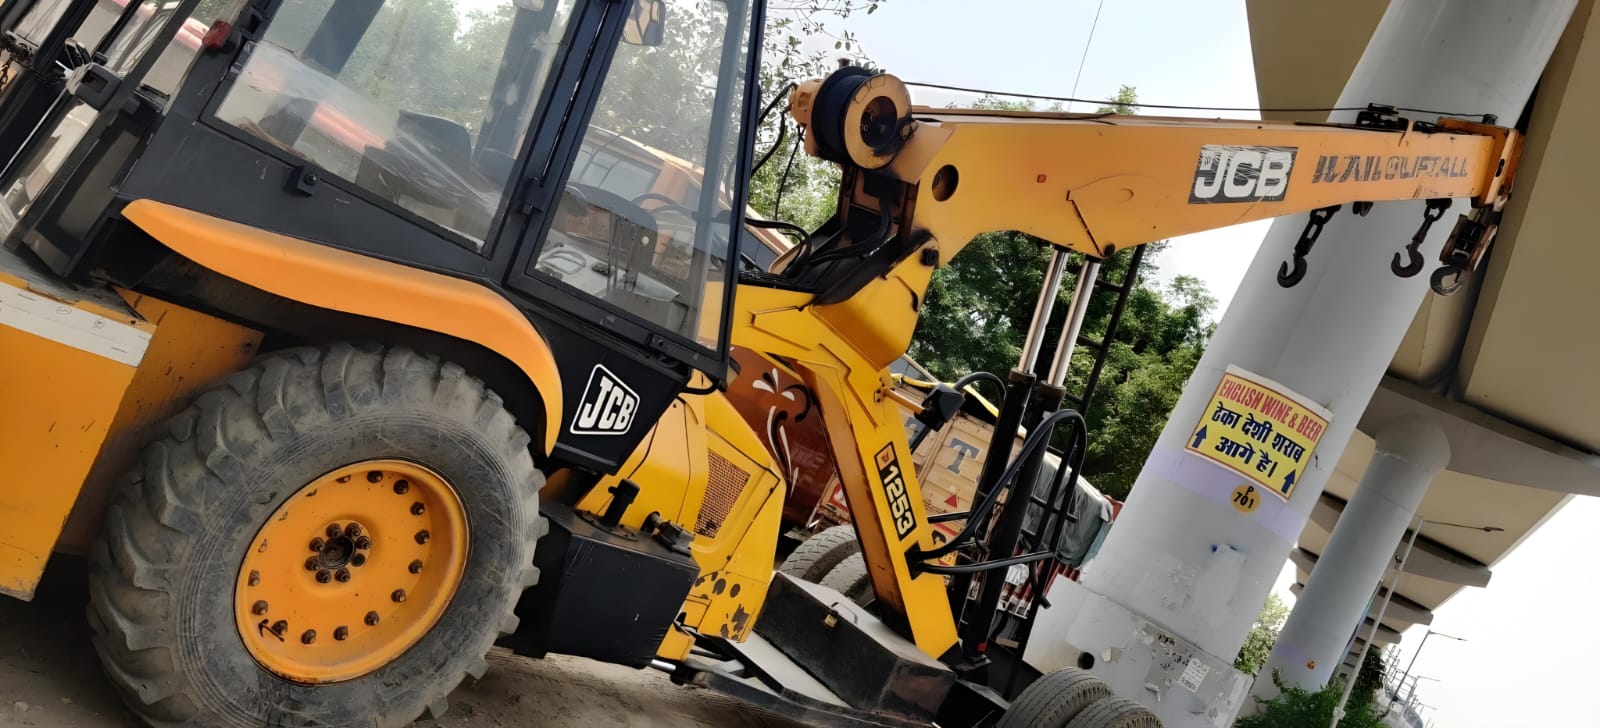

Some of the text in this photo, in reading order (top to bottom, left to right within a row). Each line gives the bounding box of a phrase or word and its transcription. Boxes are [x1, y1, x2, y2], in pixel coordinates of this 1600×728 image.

[1194, 148, 1293, 199] JCB
[578, 375, 636, 430] JCB
[1219, 379, 1323, 443] ENGLISH WINE & BEER
[1215, 436, 1256, 465] आगे
[1242, 413, 1273, 444] देशी
[1272, 432, 1306, 463] शराब
[883, 464, 914, 535] 1253
[1233, 491, 1255, 509] 701
[1245, 485, 1255, 497] P
